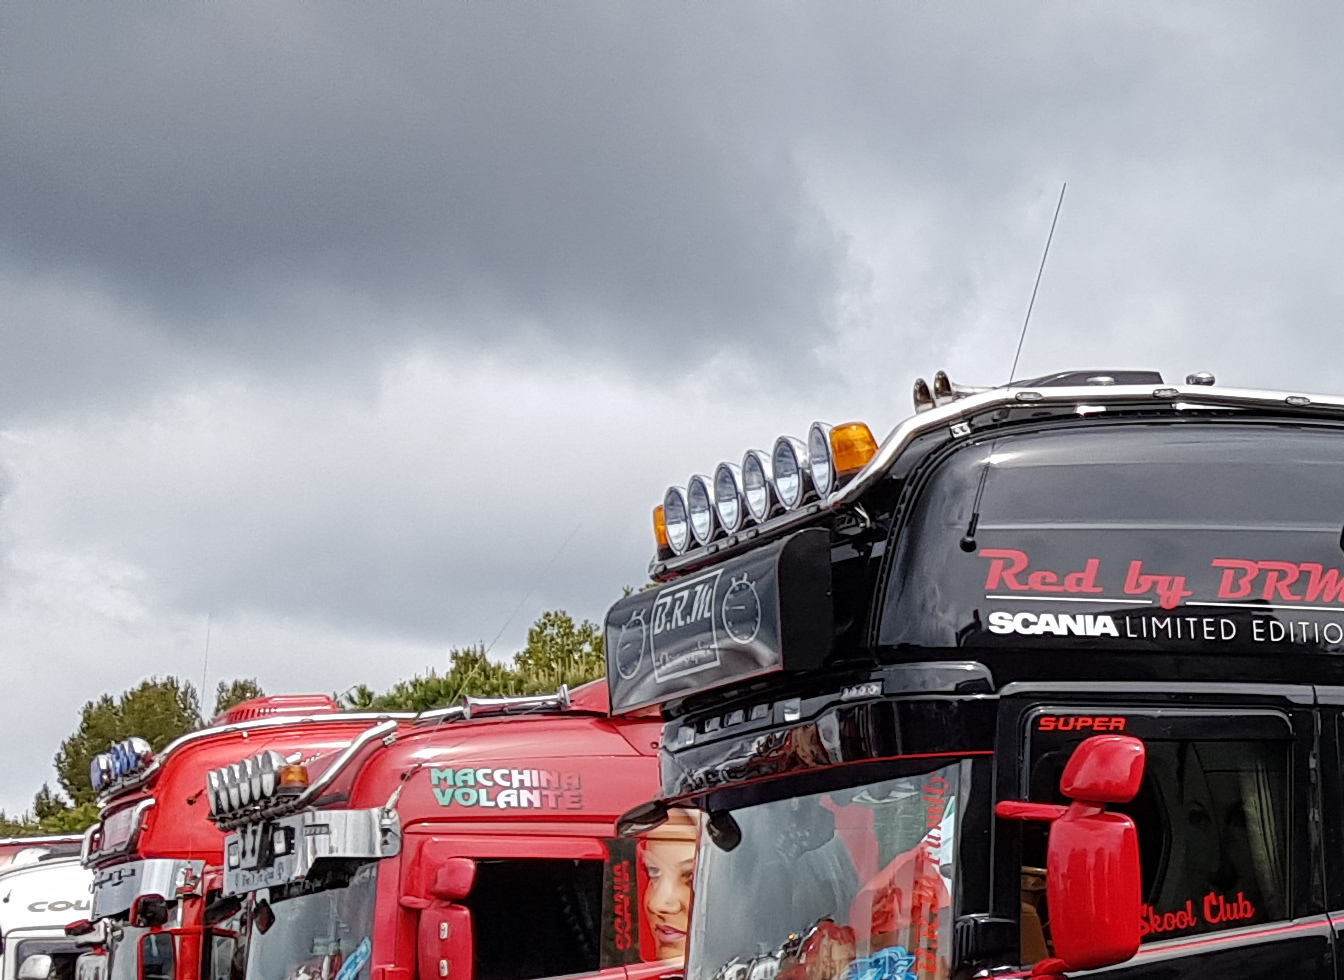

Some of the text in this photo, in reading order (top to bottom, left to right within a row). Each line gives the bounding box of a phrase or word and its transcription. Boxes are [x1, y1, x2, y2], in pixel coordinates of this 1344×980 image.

[978, 548, 1103, 593] Red
[1123, 559, 1193, 610] by
[987, 611, 1119, 637] SCANIA
[1126, 616, 1237, 641] LIMITED
[1038, 717, 1126, 731] SUPER
[430, 767, 582, 790] MACCHINA
[432, 787, 584, 811] VOLANTE
[613, 860, 631, 949] SCANIA
[1203, 892, 1256, 923] Club
